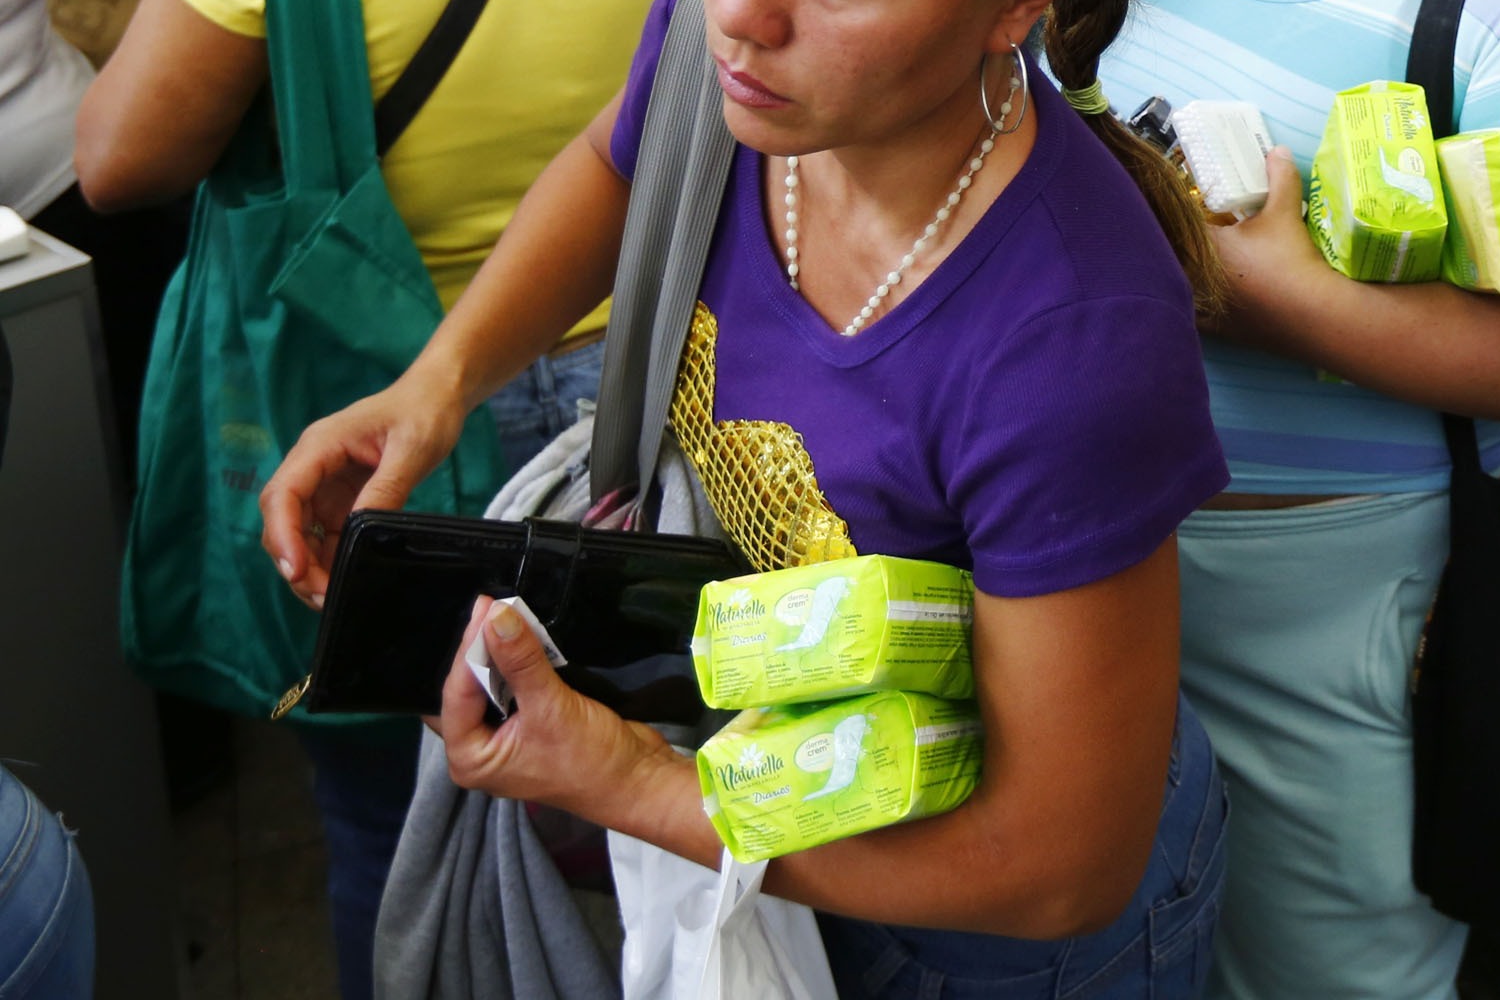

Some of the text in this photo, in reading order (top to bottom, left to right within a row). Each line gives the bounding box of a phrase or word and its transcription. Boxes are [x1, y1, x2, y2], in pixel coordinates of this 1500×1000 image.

[708, 599, 765, 631] Naturella
[716, 754, 784, 791] Naturella
[753, 785, 790, 803] Diarios
